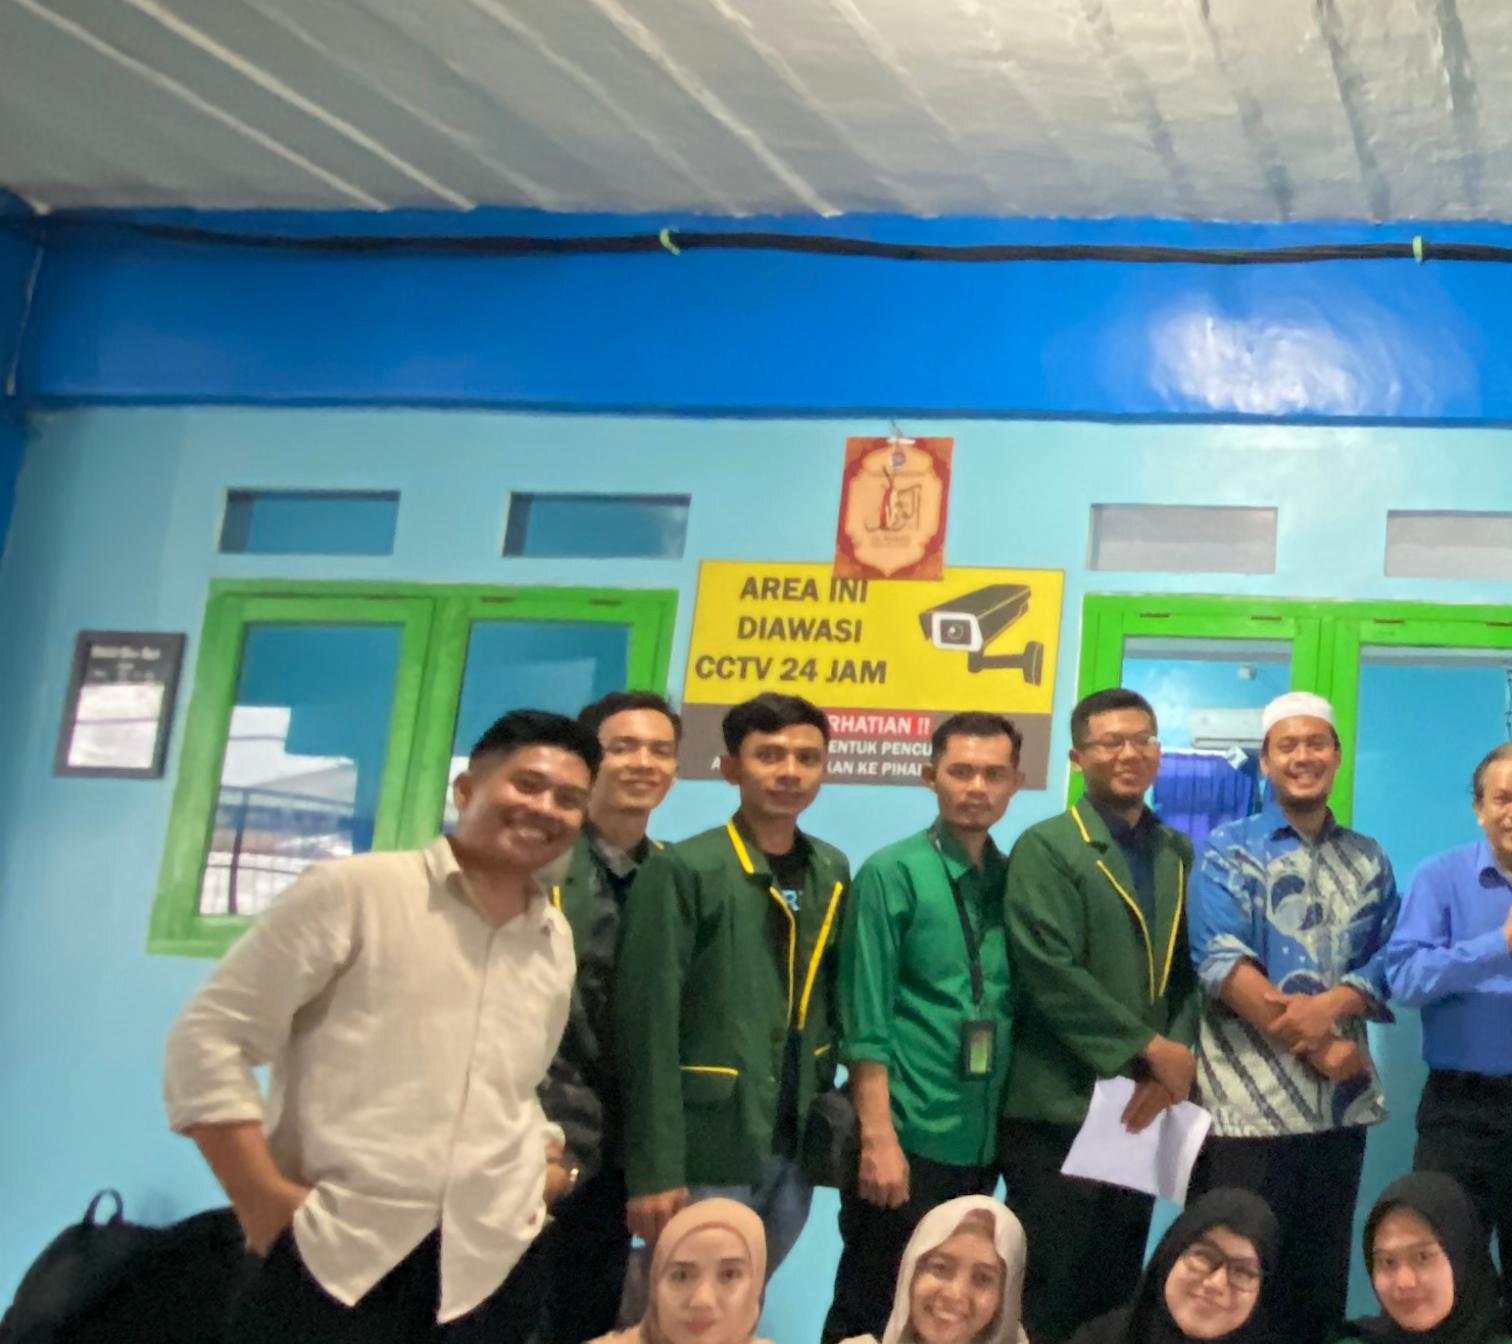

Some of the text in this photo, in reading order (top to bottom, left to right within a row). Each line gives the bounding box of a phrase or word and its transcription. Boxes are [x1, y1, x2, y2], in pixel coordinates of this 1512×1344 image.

[739, 576, 869, 604] AREA INI
[736, 616, 862, 644] DIAWASI
[694, 655, 887, 685] CCTV 24 JAM
[828, 713, 911, 735] RHATIAN
[828, 739, 932, 757] ENTUK PENCU
[857, 761, 877, 776] KE
